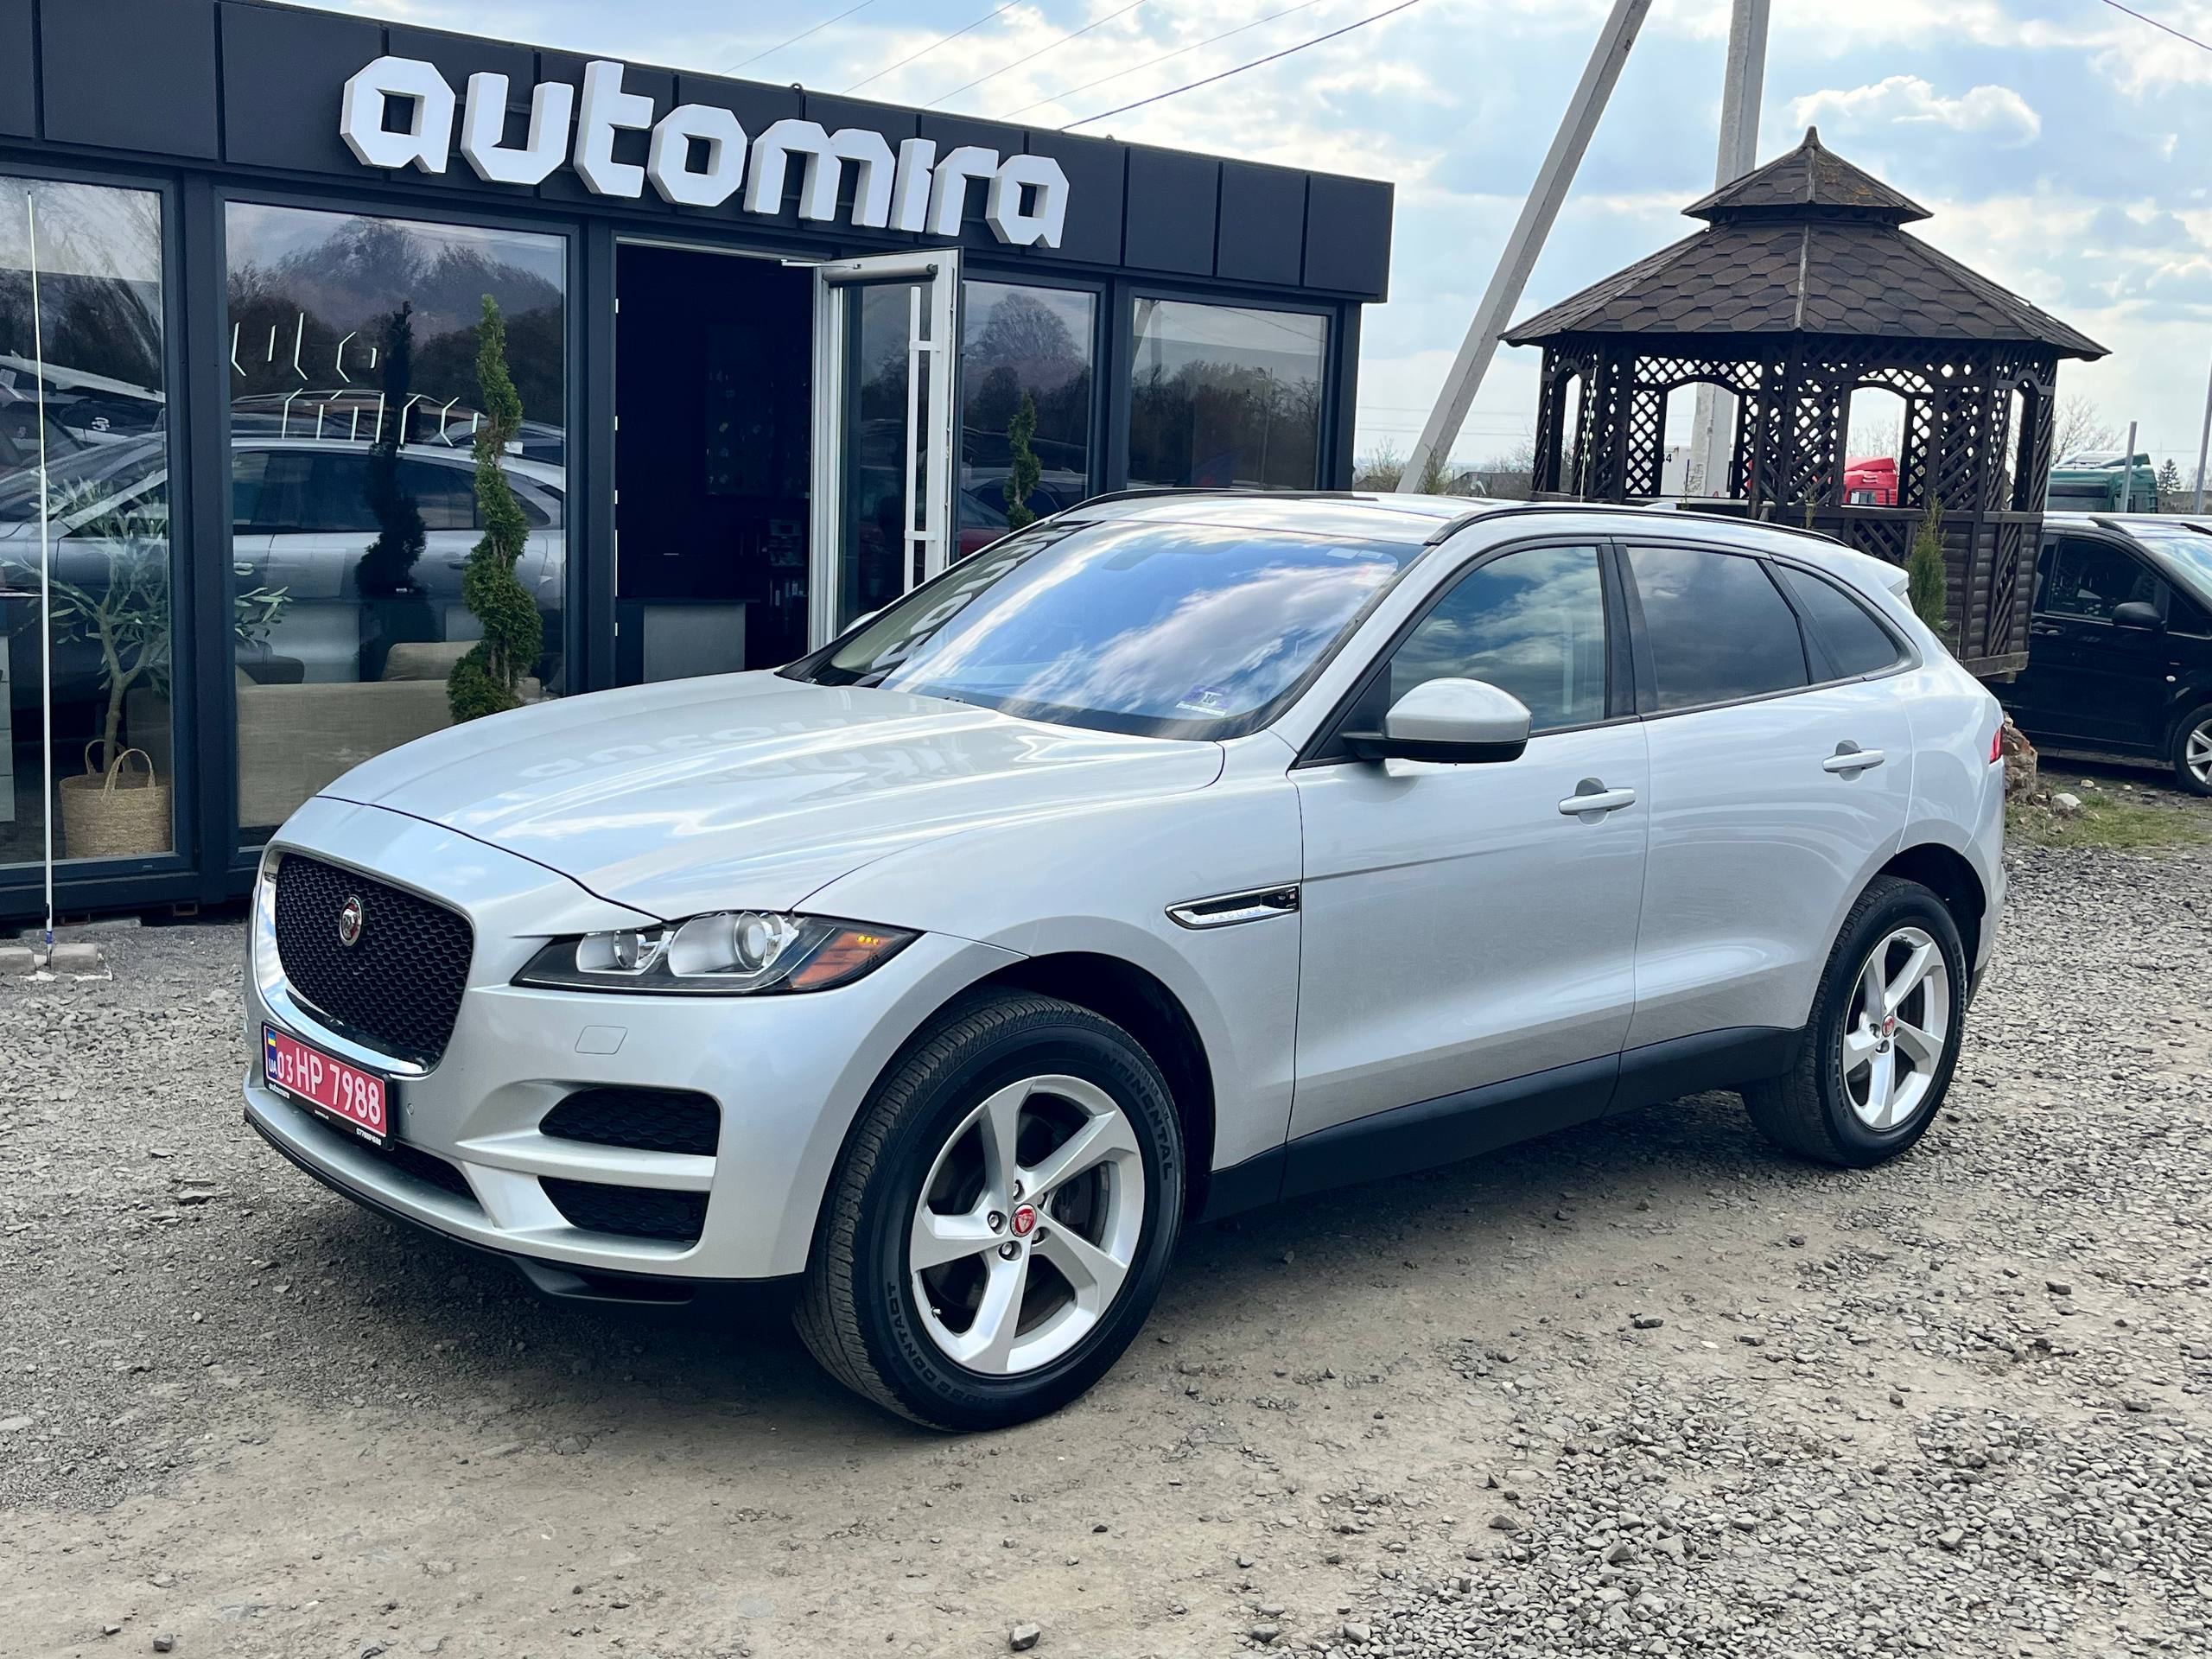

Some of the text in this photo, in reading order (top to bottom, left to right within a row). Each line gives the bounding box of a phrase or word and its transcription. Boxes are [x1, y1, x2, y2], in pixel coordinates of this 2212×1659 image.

[340, 55, 1071, 248] automira
[269, 1058, 277, 1075] UA
[329, 1064, 381, 1125] 7988
